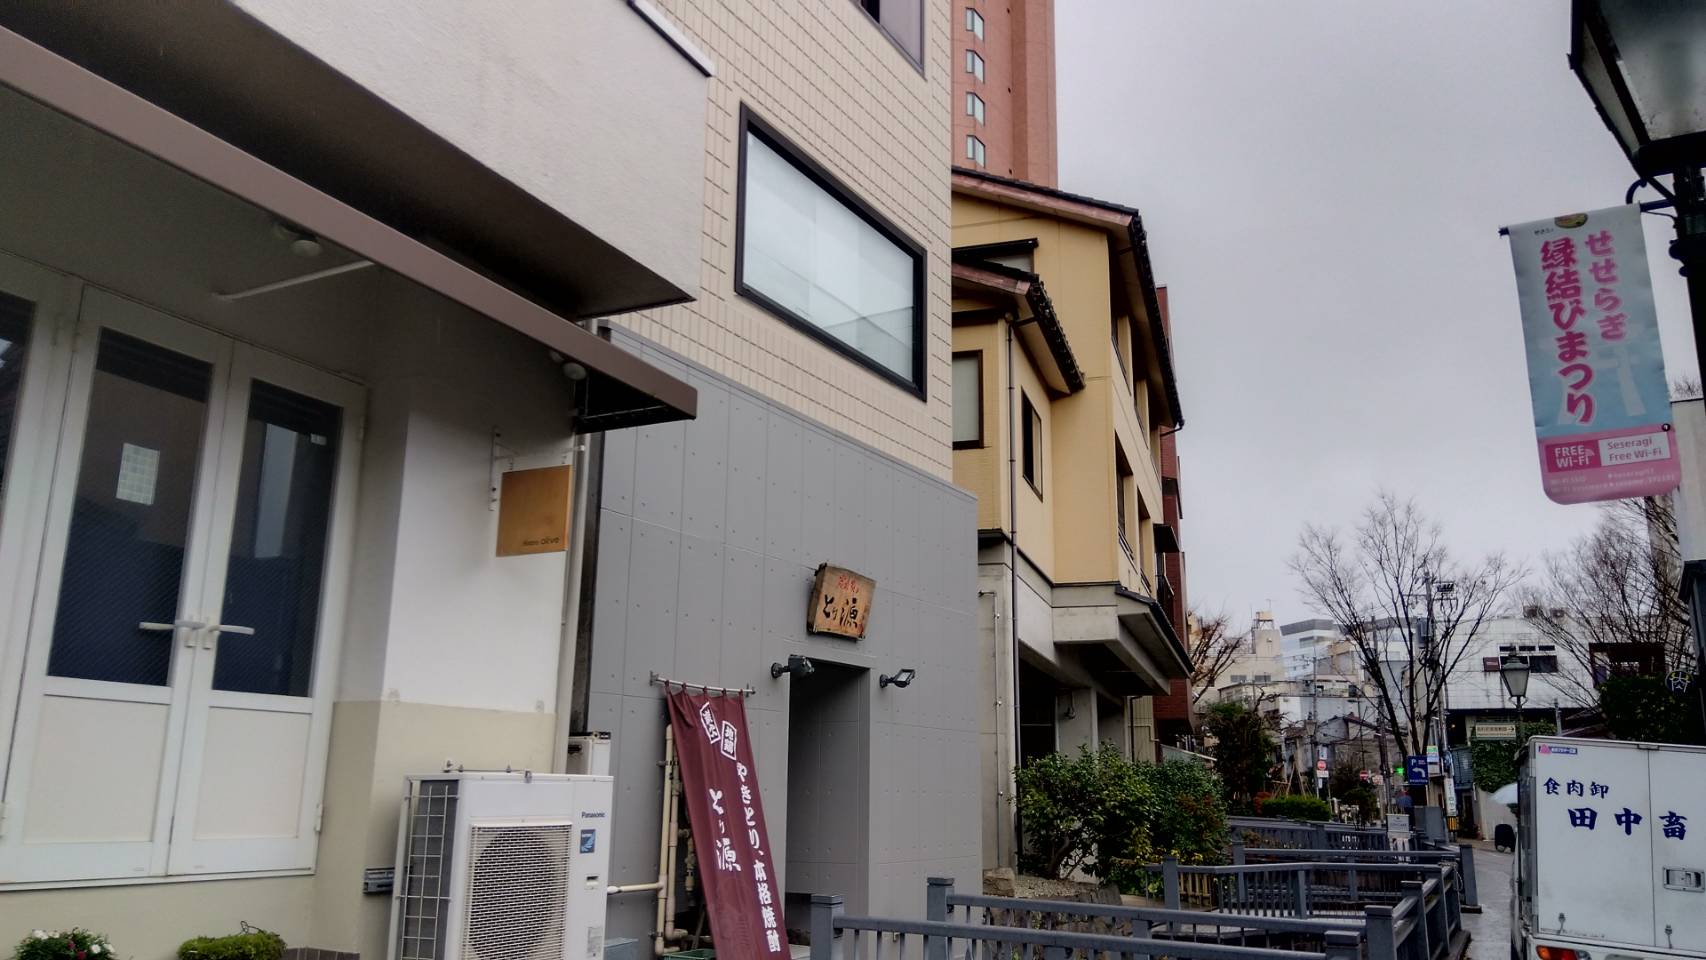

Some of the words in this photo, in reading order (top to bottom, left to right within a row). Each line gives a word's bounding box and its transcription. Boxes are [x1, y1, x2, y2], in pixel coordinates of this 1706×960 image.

[1585, 230, 1629, 341] せせらぎ
[1540, 236, 1595, 424] 縁結びまつり
[1555, 445, 1585, 457] FREE
[1607, 437, 1653, 450] Seseragi
[1609, 452, 1632, 461] Free
[1634, 448, 1662, 459] Wi-Fi
[1543, 777, 1609, 799] 食肉卸
[581, 811, 605, 819] Panasonic
[1567, 807, 1688, 840] 田中畜
[708, 788, 742, 873] とり源
